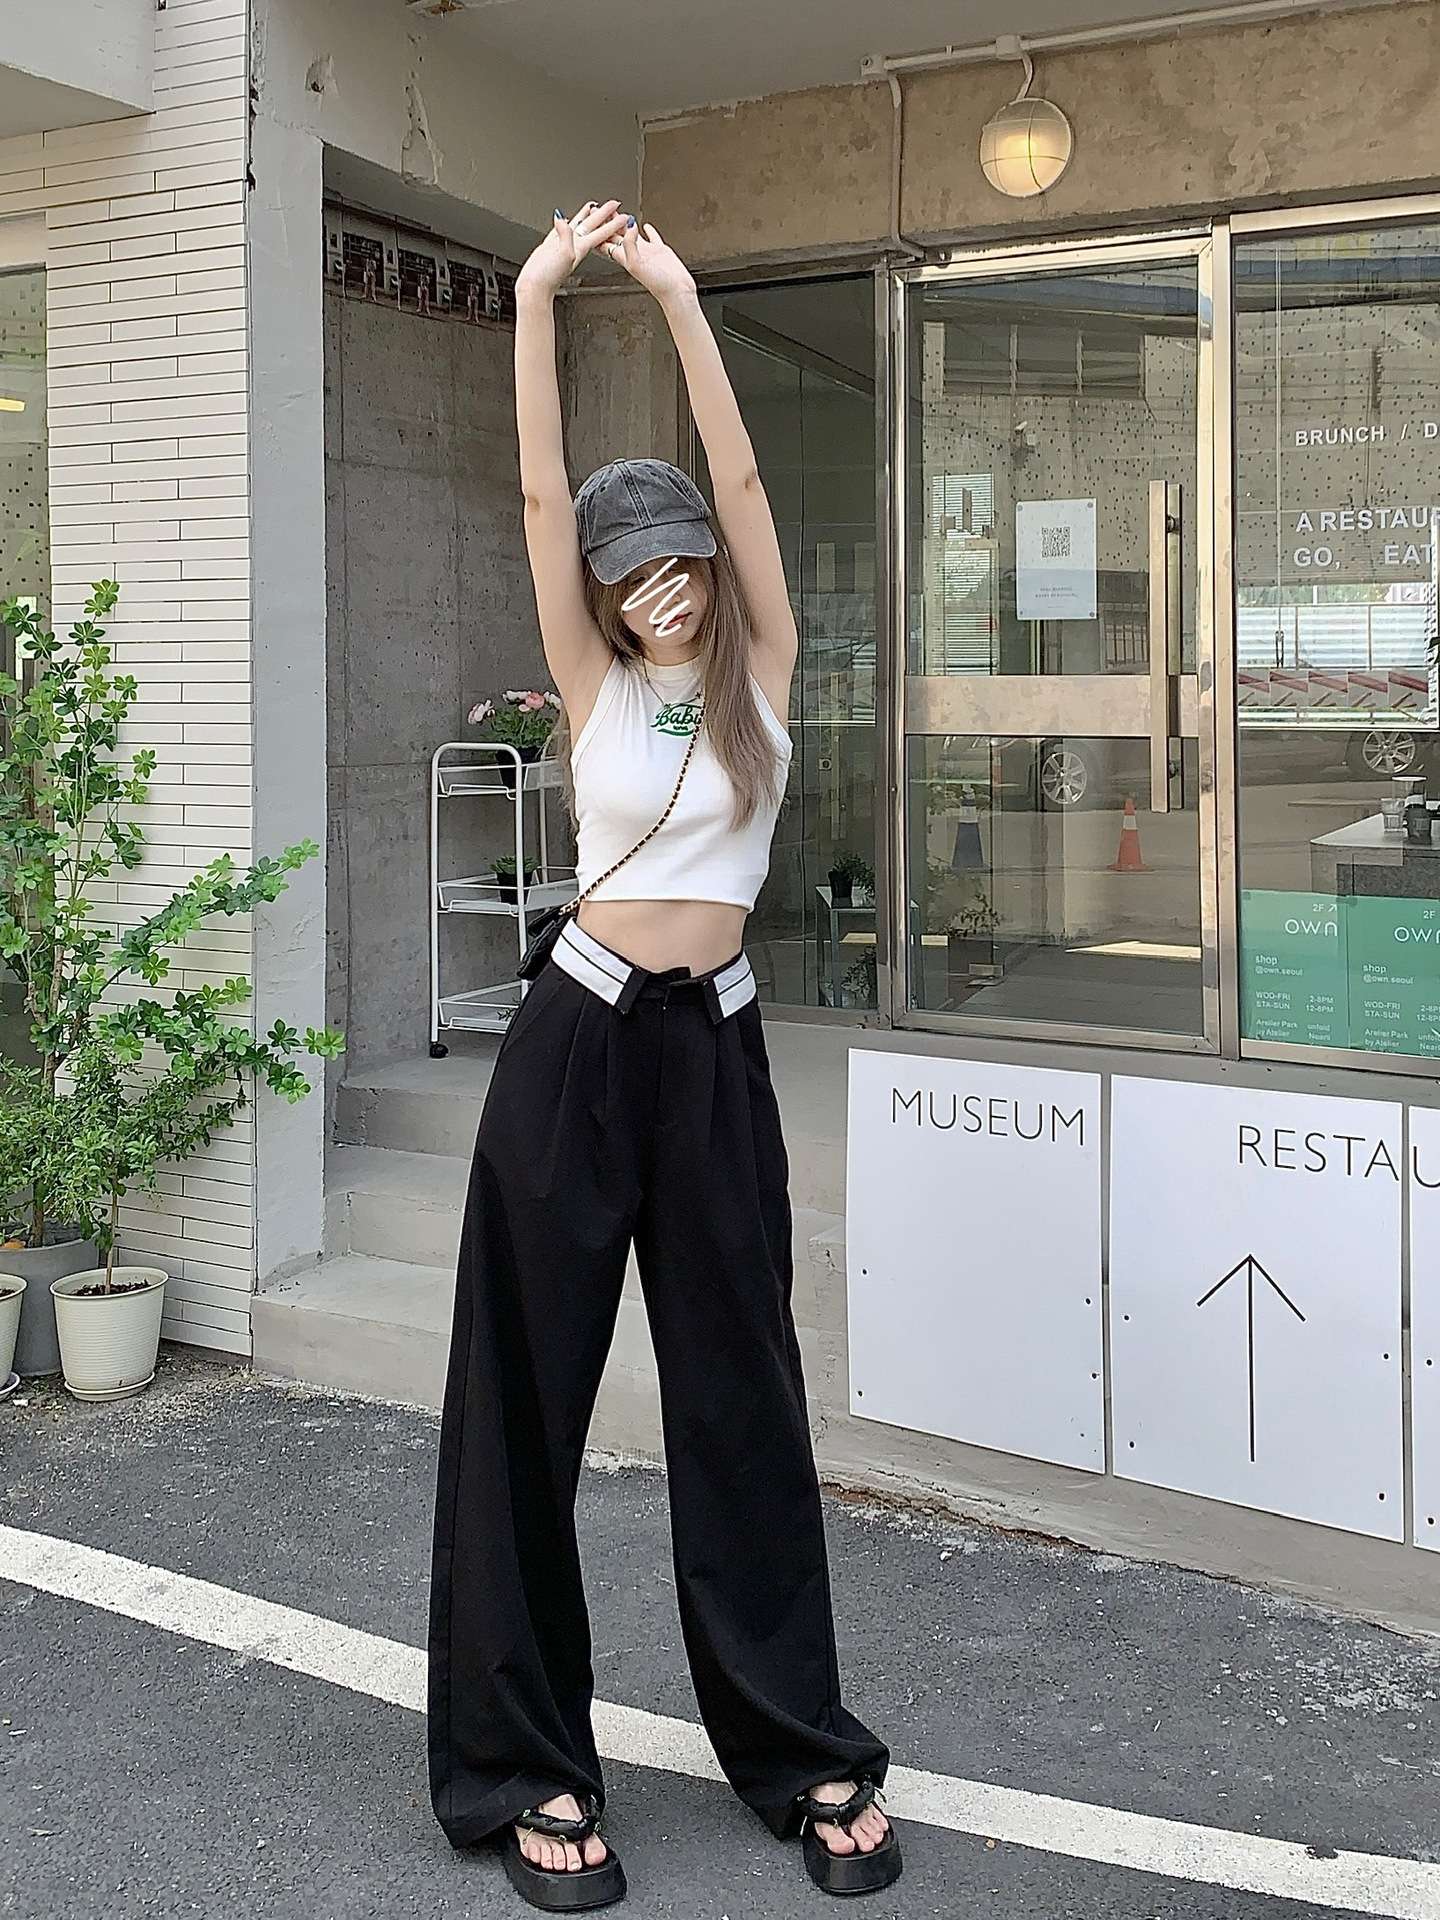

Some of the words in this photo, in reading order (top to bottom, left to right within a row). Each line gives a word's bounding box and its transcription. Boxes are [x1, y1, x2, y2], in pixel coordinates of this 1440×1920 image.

[1295, 425, 1385, 446] BRUNCH
[1295, 512, 1314, 532] A
[1293, 546, 1341, 570] GO,
[1312, 903, 1325, 912] 2F
[1423, 910, 1436, 919] 2F
[1255, 954, 1278, 966] shop
[1363, 964, 1387, 974] shop
[890, 1087, 1085, 1147] MUSEUM
[1237, 1124, 1440, 1189] RESTAU
